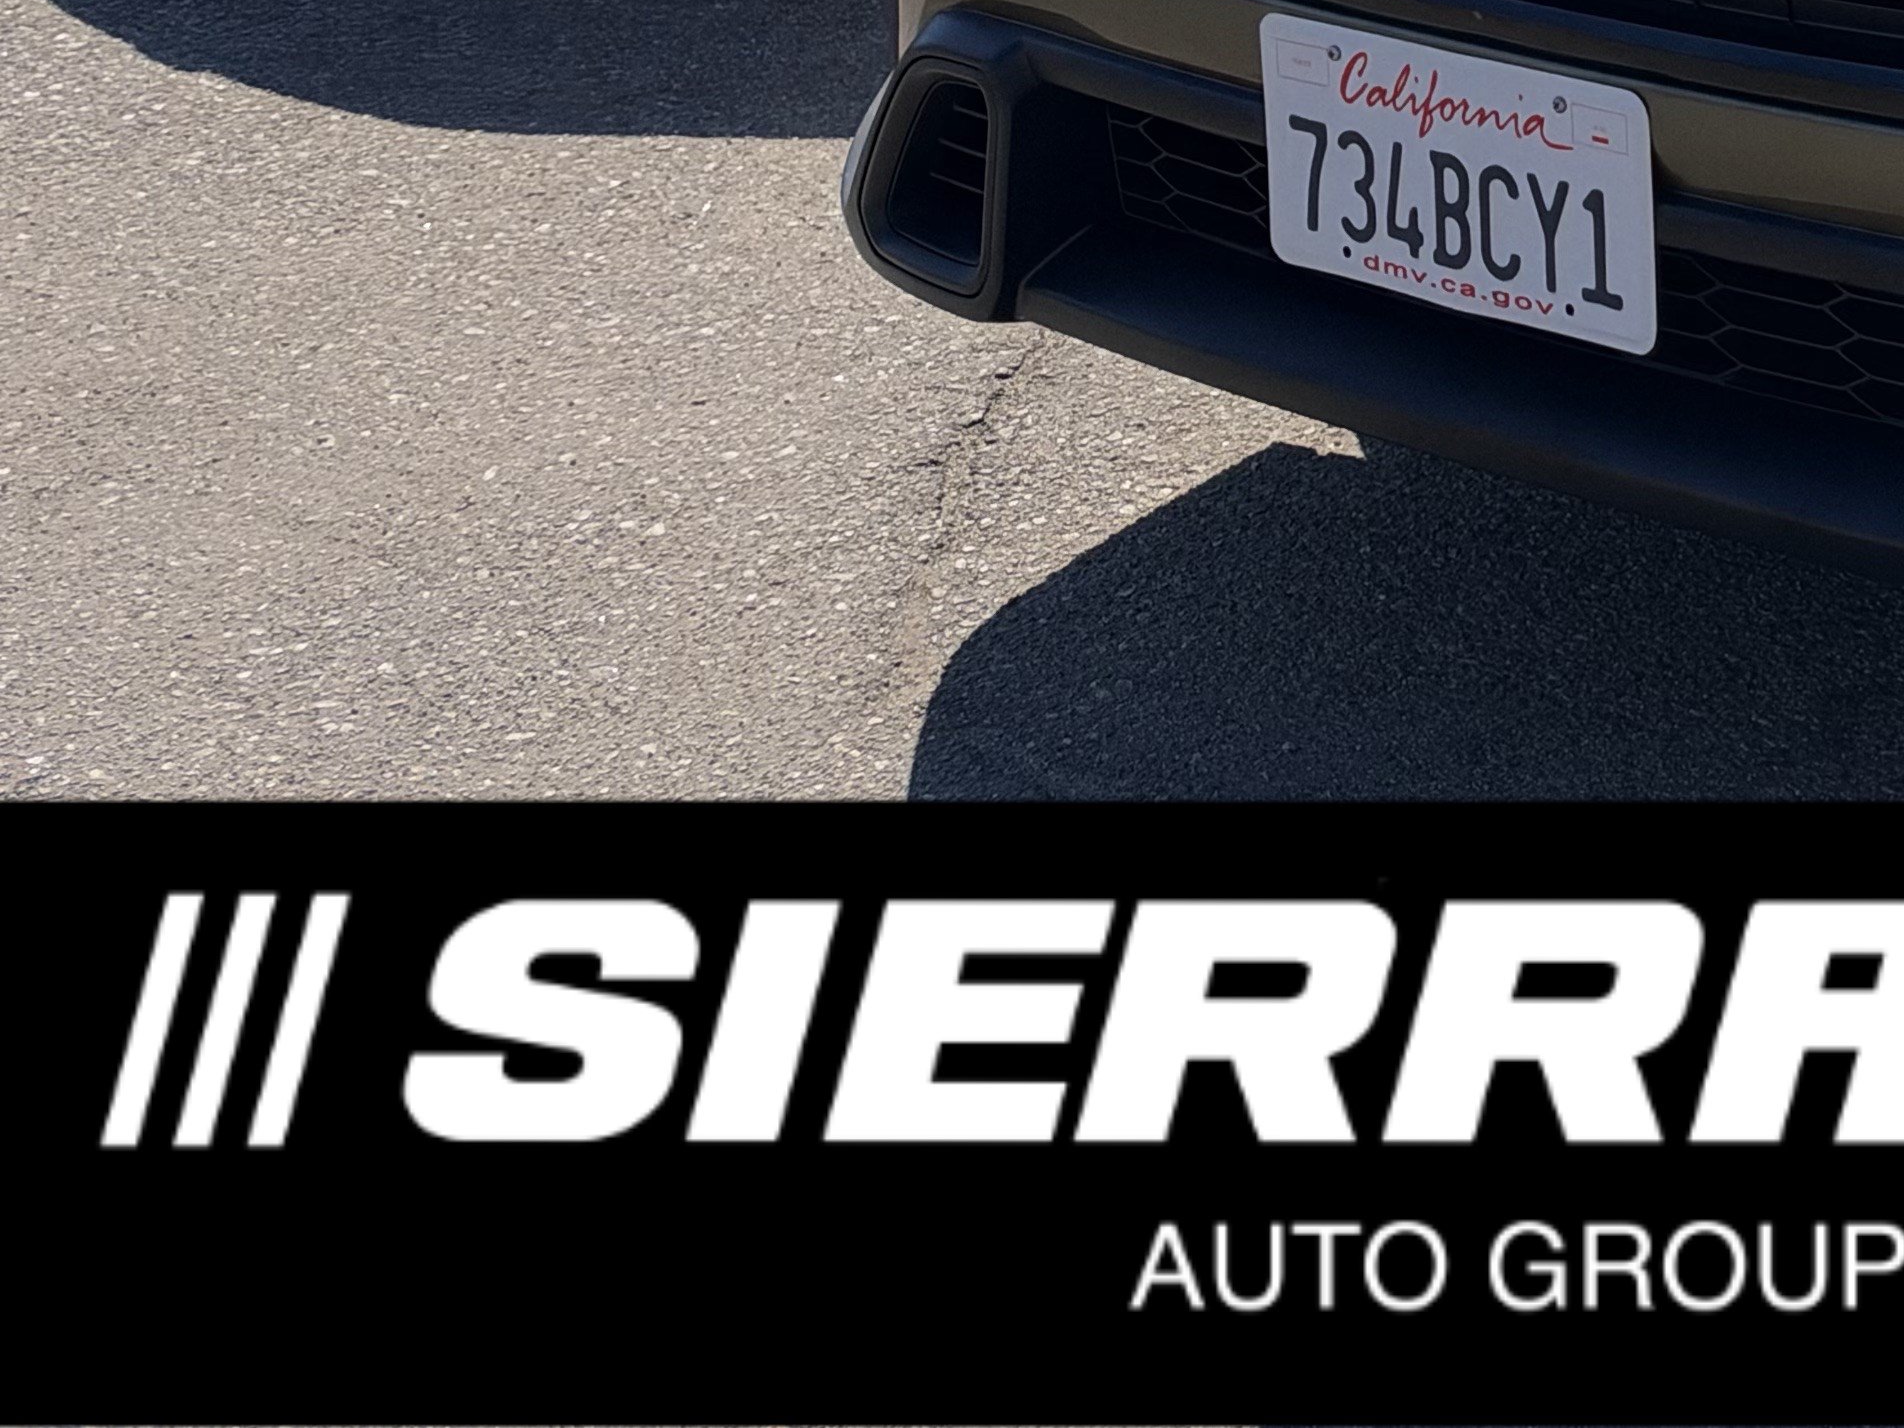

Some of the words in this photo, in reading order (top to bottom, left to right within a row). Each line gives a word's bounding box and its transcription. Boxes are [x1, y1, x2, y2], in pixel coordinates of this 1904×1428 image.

[1339, 51, 1574, 150] California
[1288, 114, 1624, 311] 734BCY1
[1363, 254, 1554, 315] dmv.ca.gov
